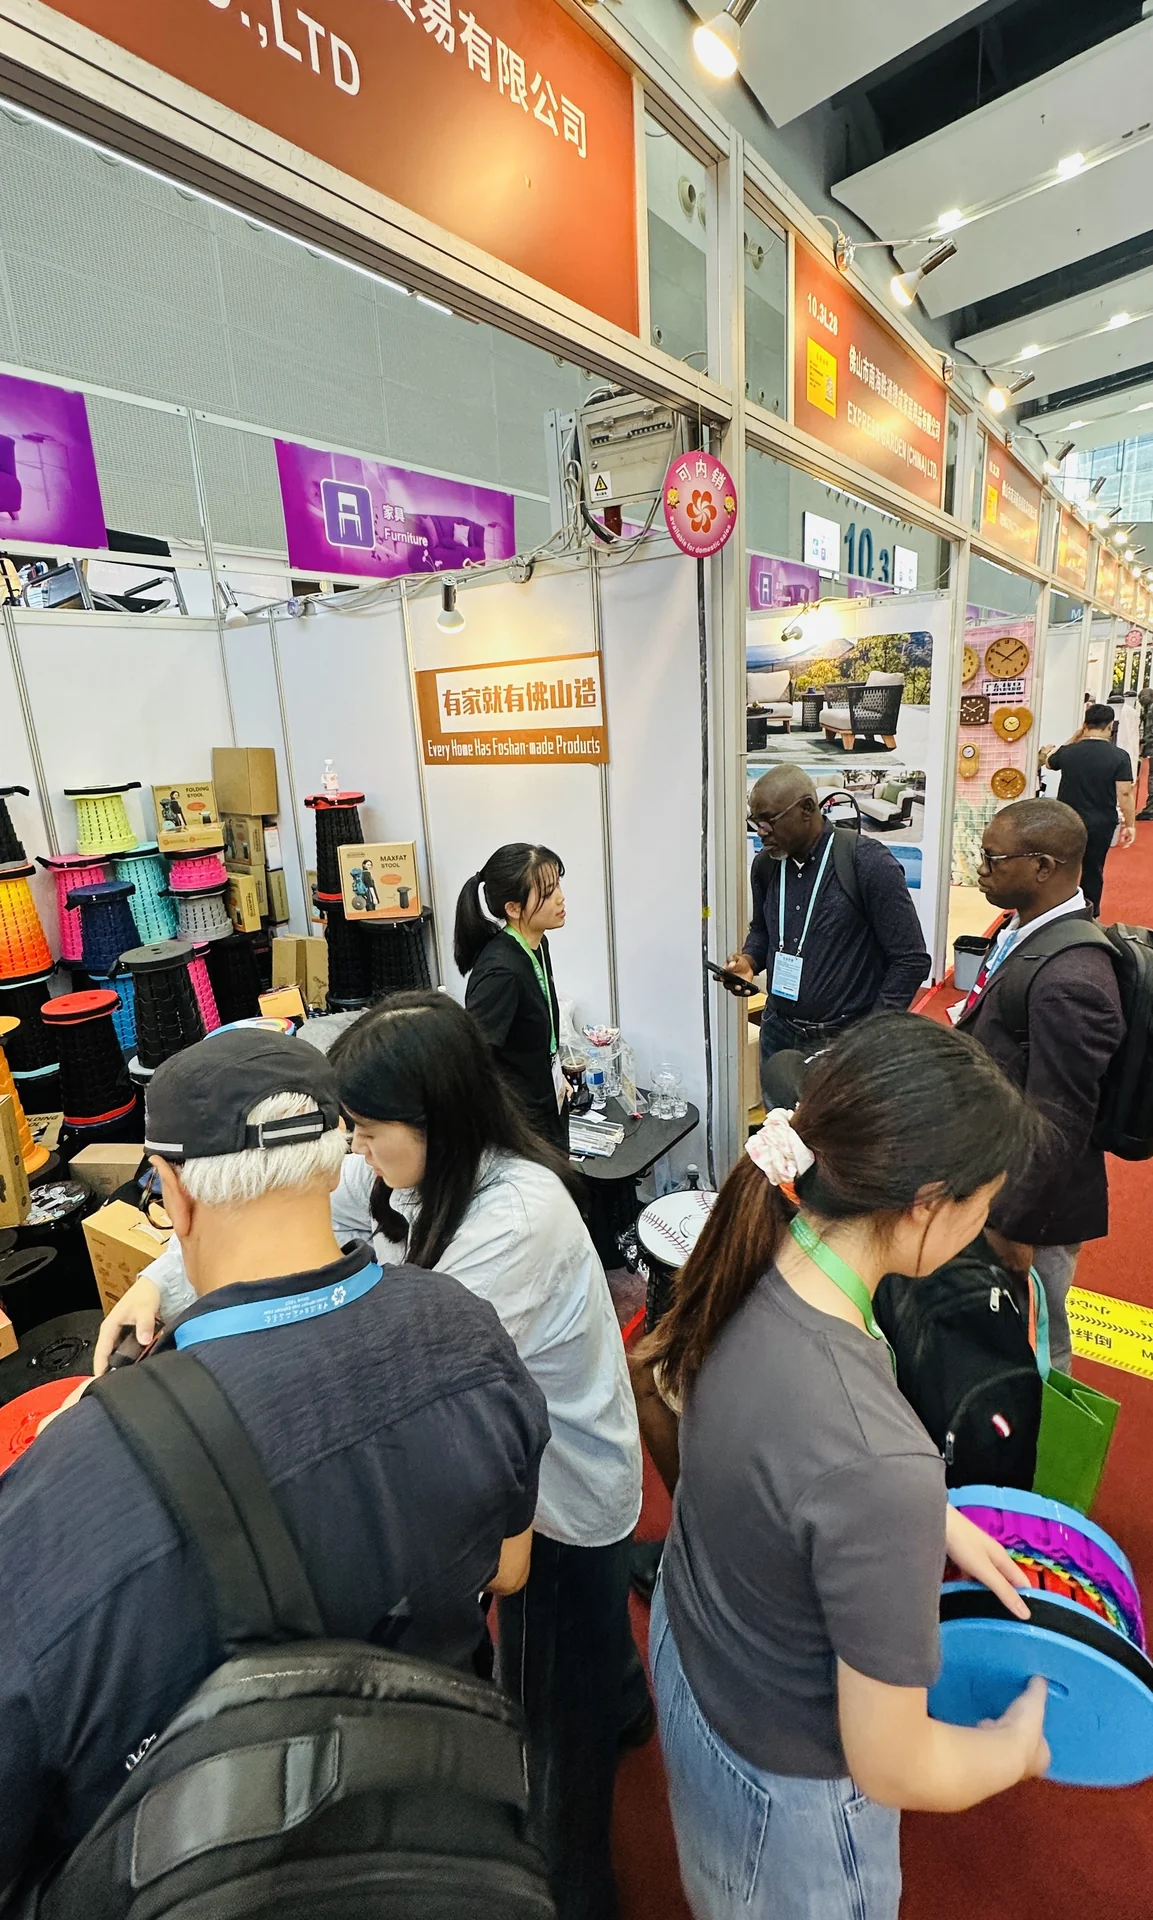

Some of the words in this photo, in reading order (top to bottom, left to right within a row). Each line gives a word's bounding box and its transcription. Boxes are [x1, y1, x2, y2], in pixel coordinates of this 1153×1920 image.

[208, 0, 361, 96] .,LTD
[807, 292, 838, 337] 10.3L28
[676, 459, 727, 491] 可内销
[382, 503, 406, 524] 家具
[384, 527, 429, 548] Furniture
[669, 516, 687, 548] available
[686, 542, 696, 552] for
[695, 541, 721, 554] domestic
[720, 524, 732, 543] sales
[442, 676, 597, 717] 有家就有佛山造
[427, 739, 450, 761] Every
[450, 738, 474, 757] Home
[474, 737, 492, 756] Has
[492, 735, 555, 756] Foshan-made
[555, 733, 601, 755] Products
[380, 854, 407, 862] MAXFAT
[1070, 1328, 1112, 1349] 绊倒
